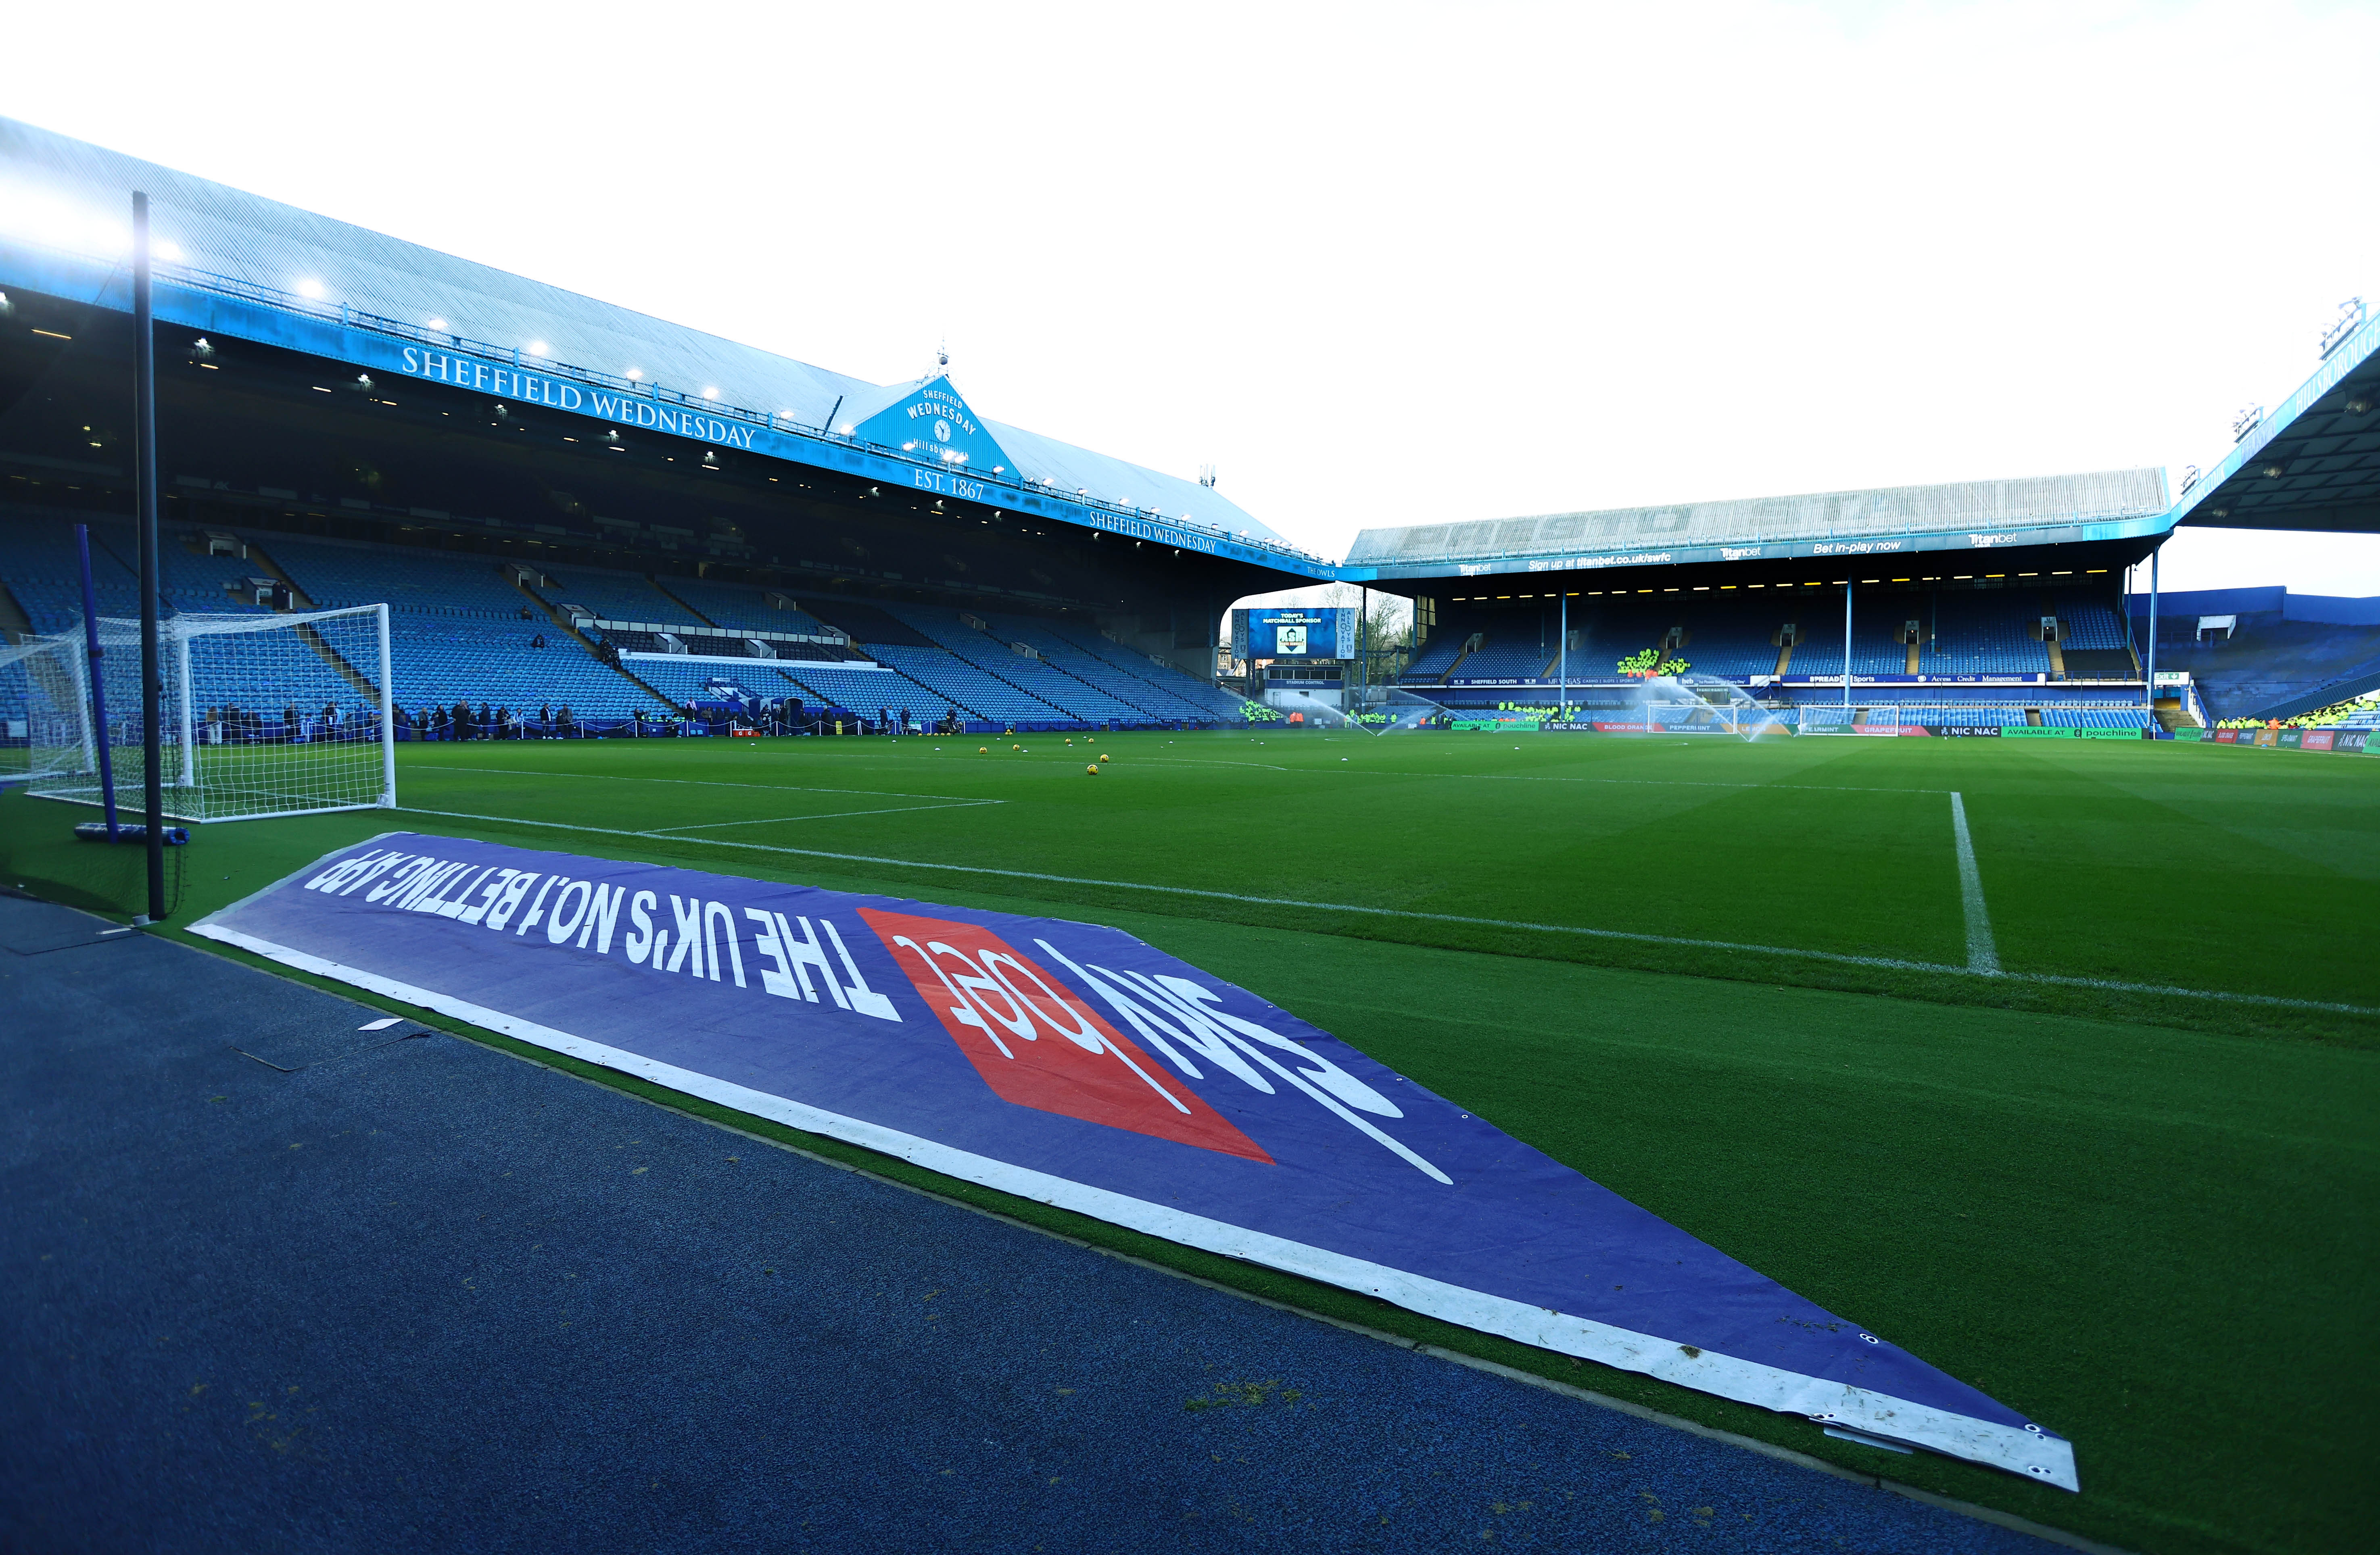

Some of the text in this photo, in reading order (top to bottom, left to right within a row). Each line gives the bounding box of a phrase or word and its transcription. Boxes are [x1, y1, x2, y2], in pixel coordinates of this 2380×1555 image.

[403, 347, 756, 449] SHEFFIELD WEDNESDAY
[923, 390, 962, 409] SHEFFIELD
[907, 402, 976, 436] WEDNESDAY
[914, 469, 984, 500] EST. 1867
[1090, 511, 1216, 553] SHEFFIELD WEDNESDAY
[1968, 532, 2017, 544] Titanbet
[1720, 546, 1761, 557] Titanbet
[1813, 542, 1901, 554] Bet in-play now
[1458, 563, 1491, 573] Titanbet
[1528, 552, 1671, 571] Sign up at titanbet.co.uk/swfc
[1307, 566, 1335, 577] THE OWLS
[1281, 632, 1303, 642] ASH
[2086, 729, 2136, 737] pouchline
[2342, 734, 2370, 747] NIC NAC
[305, 849, 1454, 1184] sky bet THE UK'S NO.1 BETTING APP
